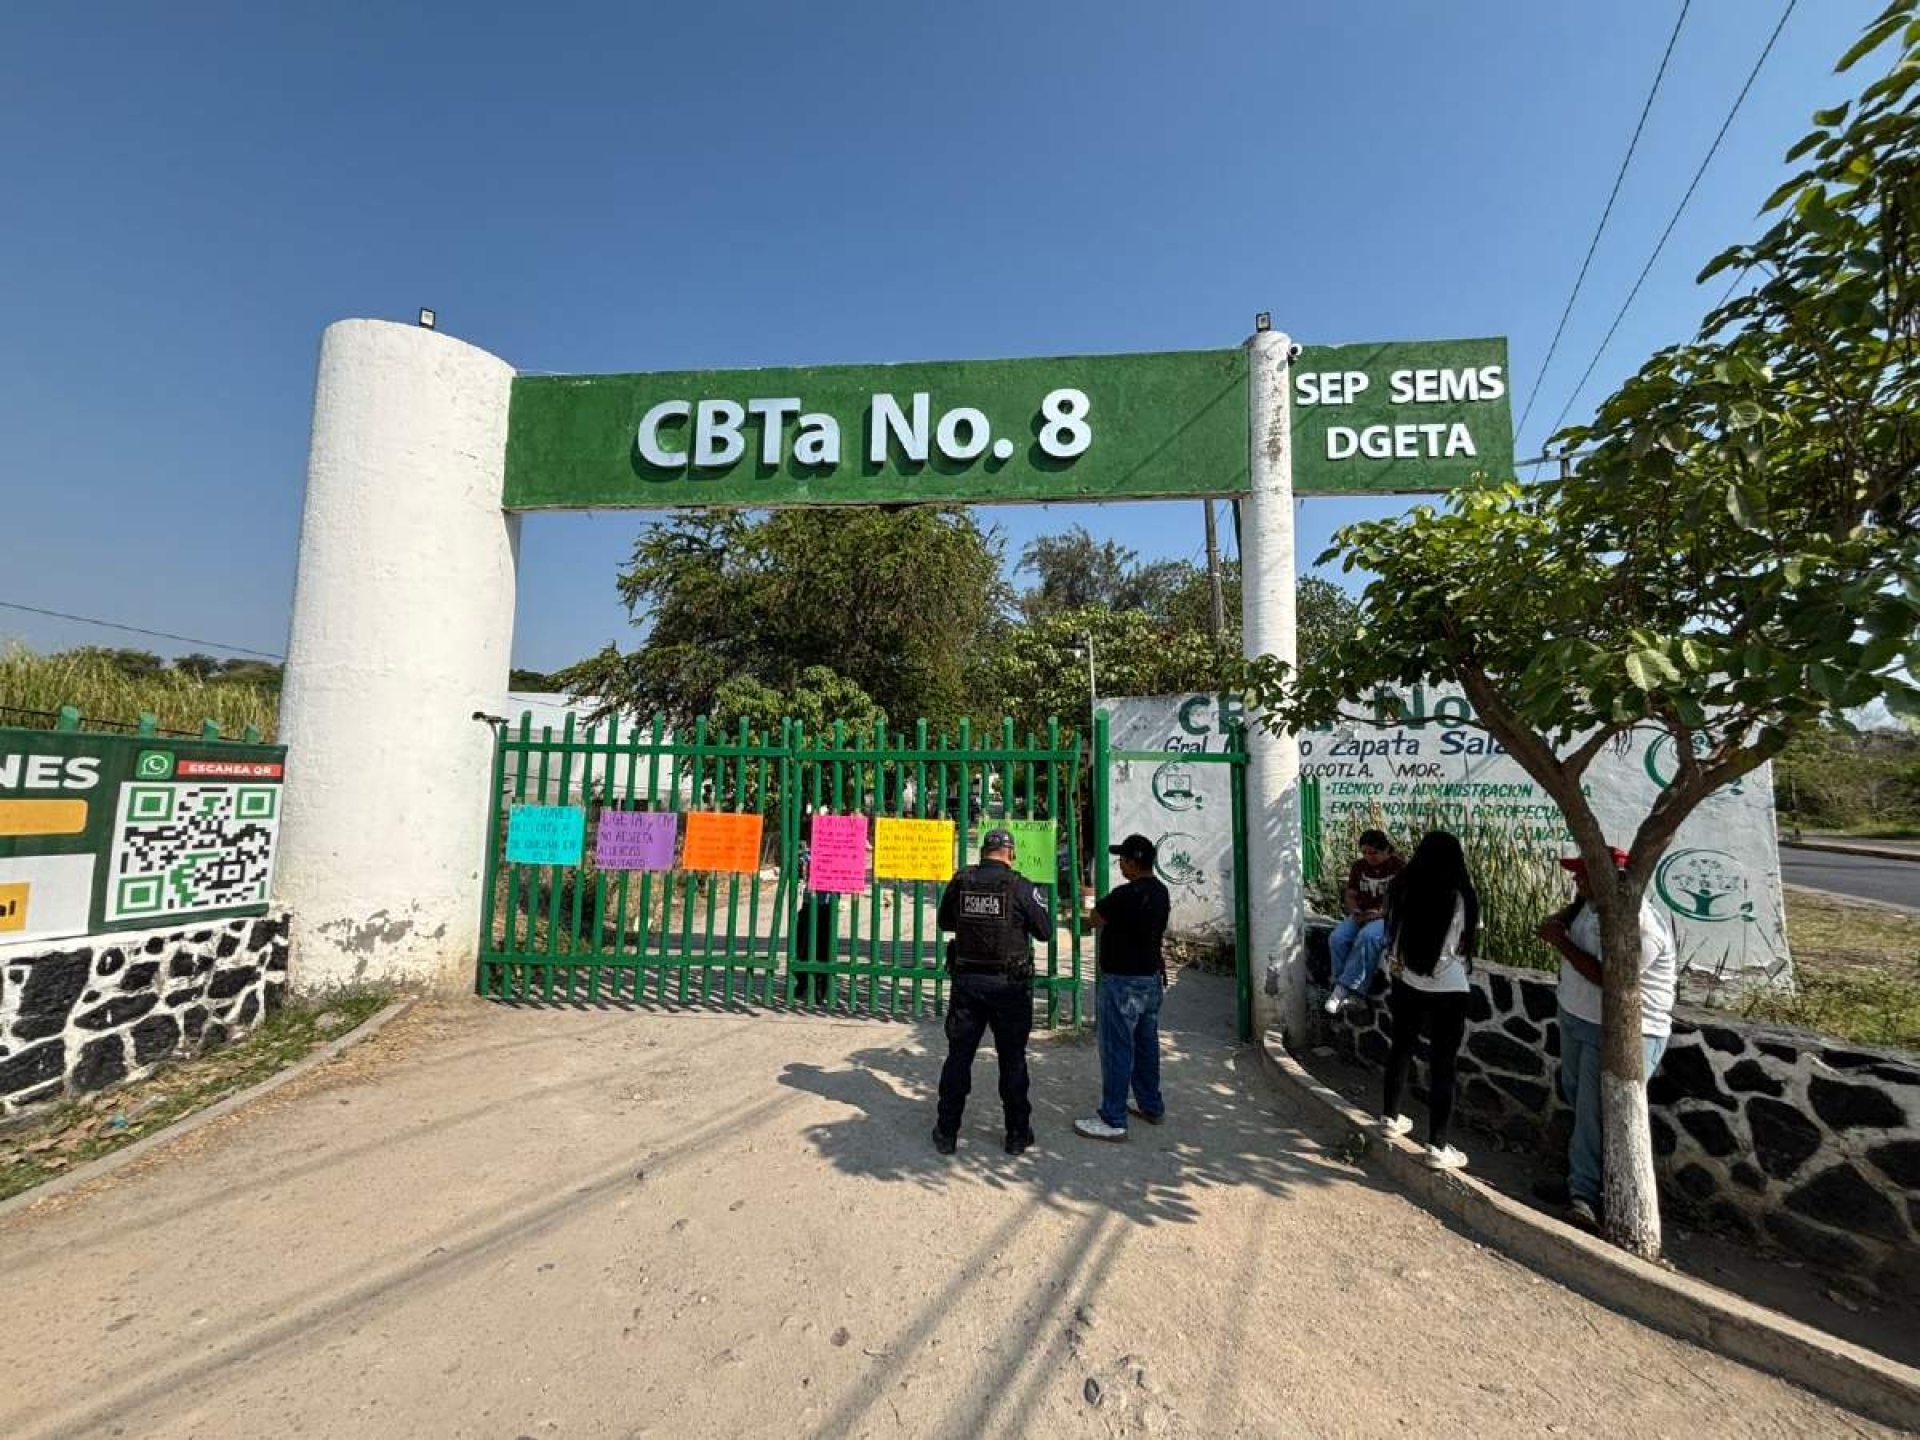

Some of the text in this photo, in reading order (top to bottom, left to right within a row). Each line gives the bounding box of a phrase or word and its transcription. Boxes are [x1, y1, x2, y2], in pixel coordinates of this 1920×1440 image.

[1296, 365, 1505, 406] SEP SEMS
[638, 388, 1092, 467] CBTa No. 8
[1327, 422, 1477, 460] DGETA
[1330, 730, 1420, 763] Zapata
[1440, 730, 1506, 755] Sala
[1300, 762, 1446, 778] OCOTLA. MOR.
